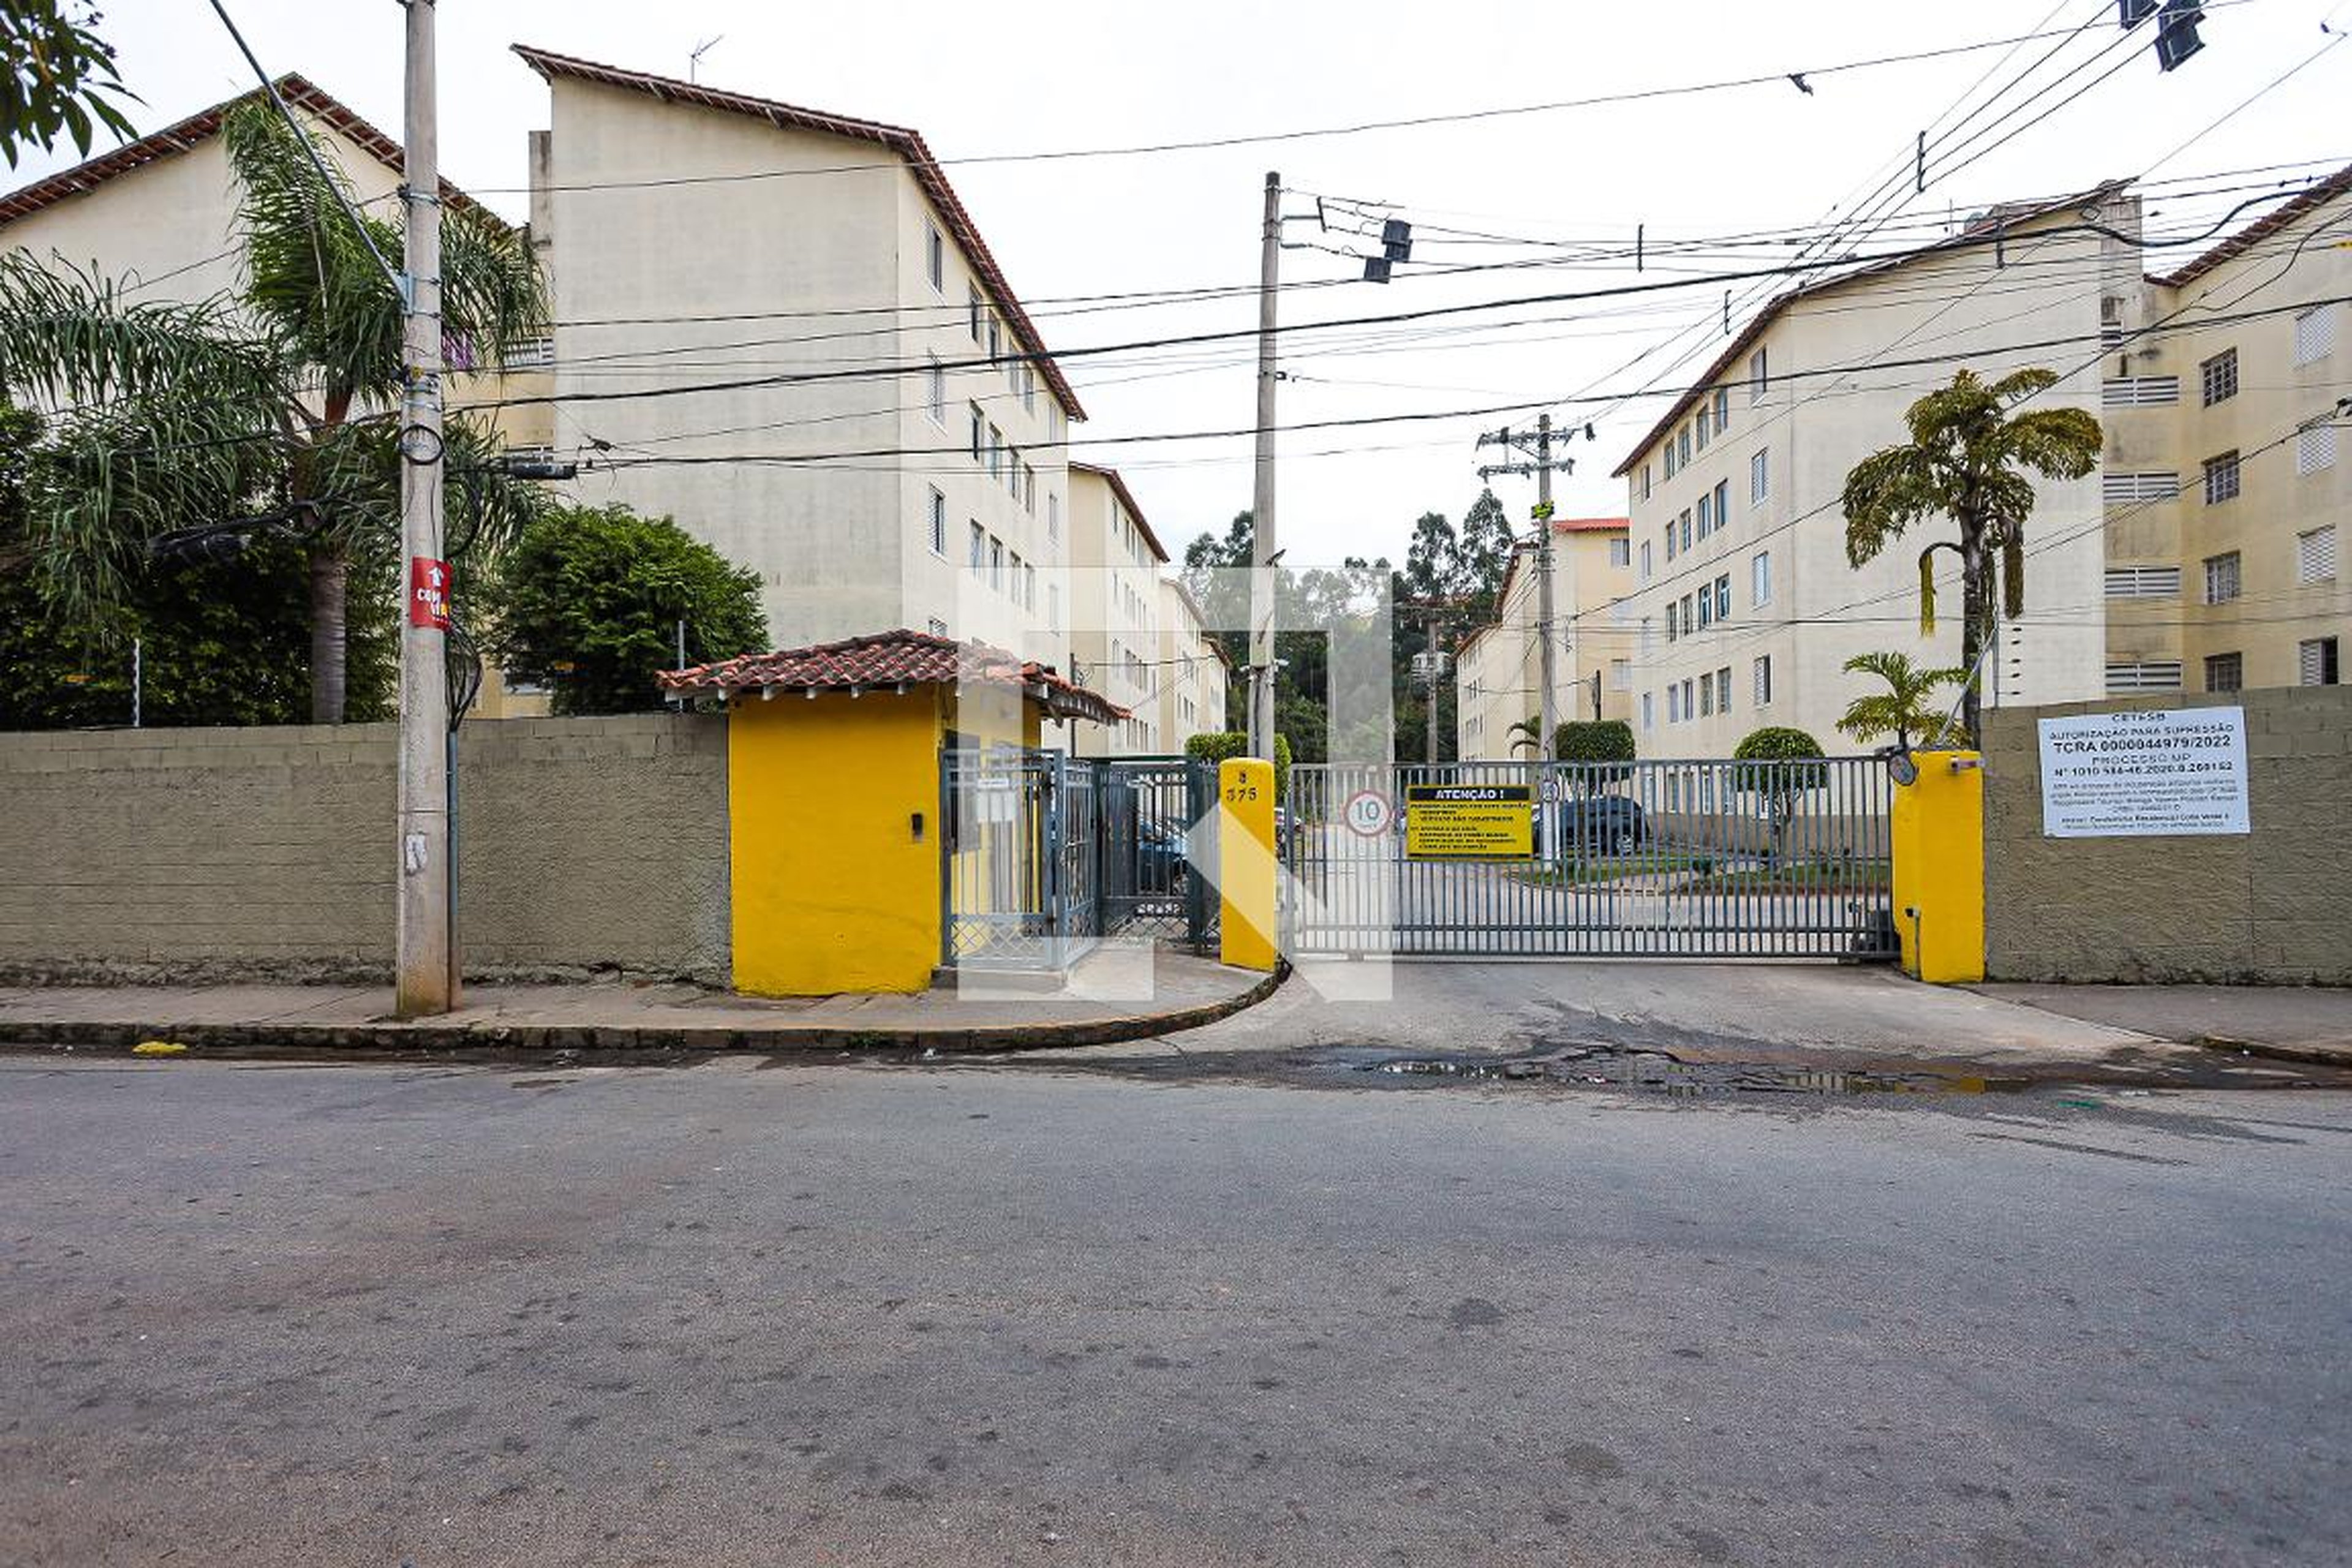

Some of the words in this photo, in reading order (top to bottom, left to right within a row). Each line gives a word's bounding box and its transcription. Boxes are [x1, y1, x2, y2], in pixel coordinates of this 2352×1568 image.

[2130, 726, 2161, 736] PARA
[2053, 741, 2098, 754] TCRA
[1435, 789, 1498, 801] ATENÇÃO
[1355, 801, 1381, 821] 10
